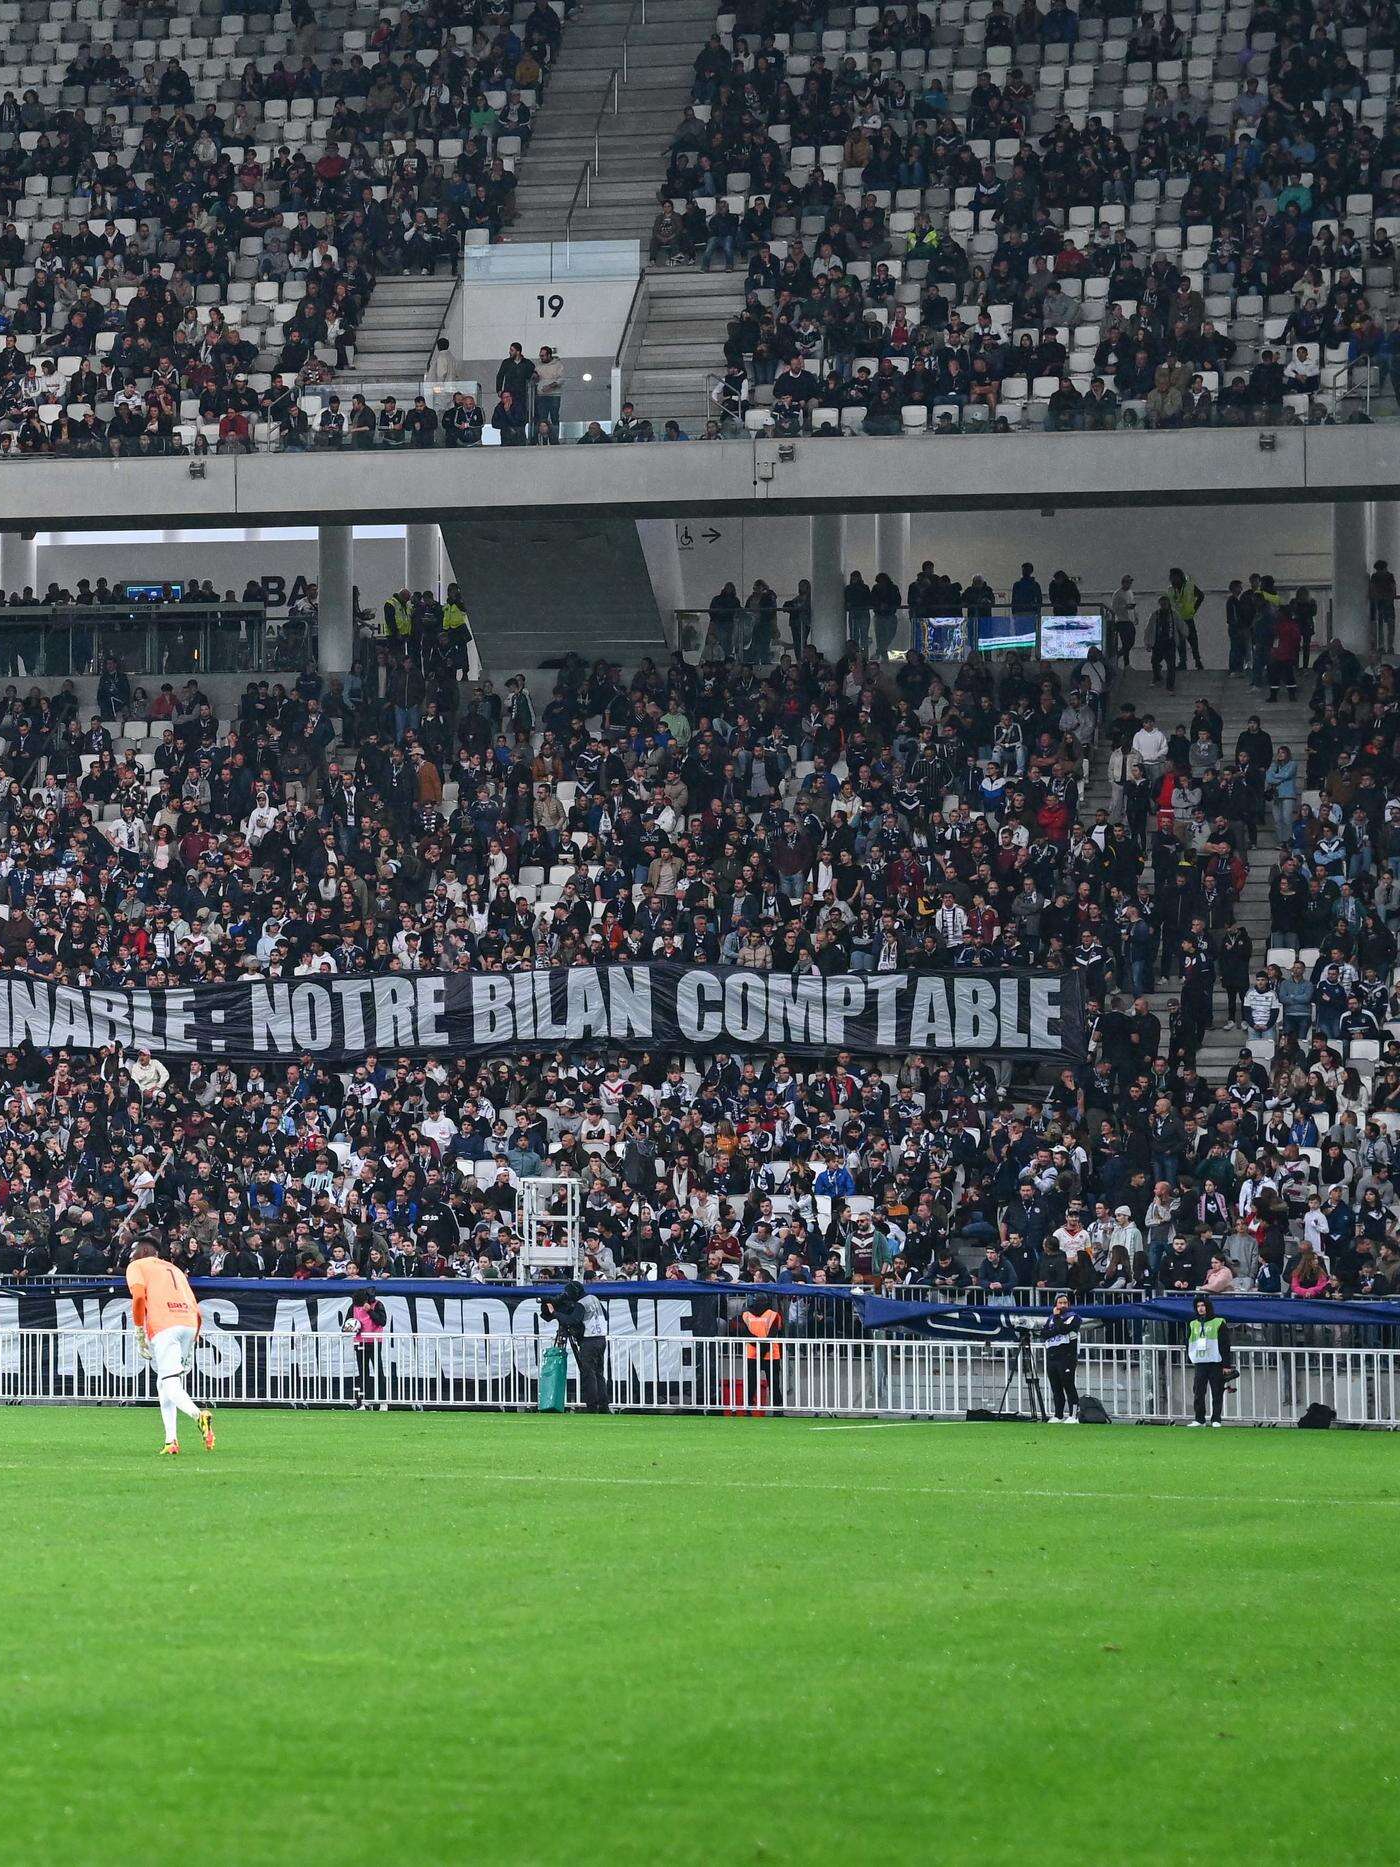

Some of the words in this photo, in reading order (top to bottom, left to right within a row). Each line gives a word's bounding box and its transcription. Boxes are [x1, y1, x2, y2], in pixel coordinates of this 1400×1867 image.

[537, 294, 564, 318] 19
[251, 976, 450, 1053] NOTRE
[472, 966, 653, 1044] BILAN
[676, 970, 1062, 1049] COMPTABLE
[55, 1298, 242, 1379] NOS
